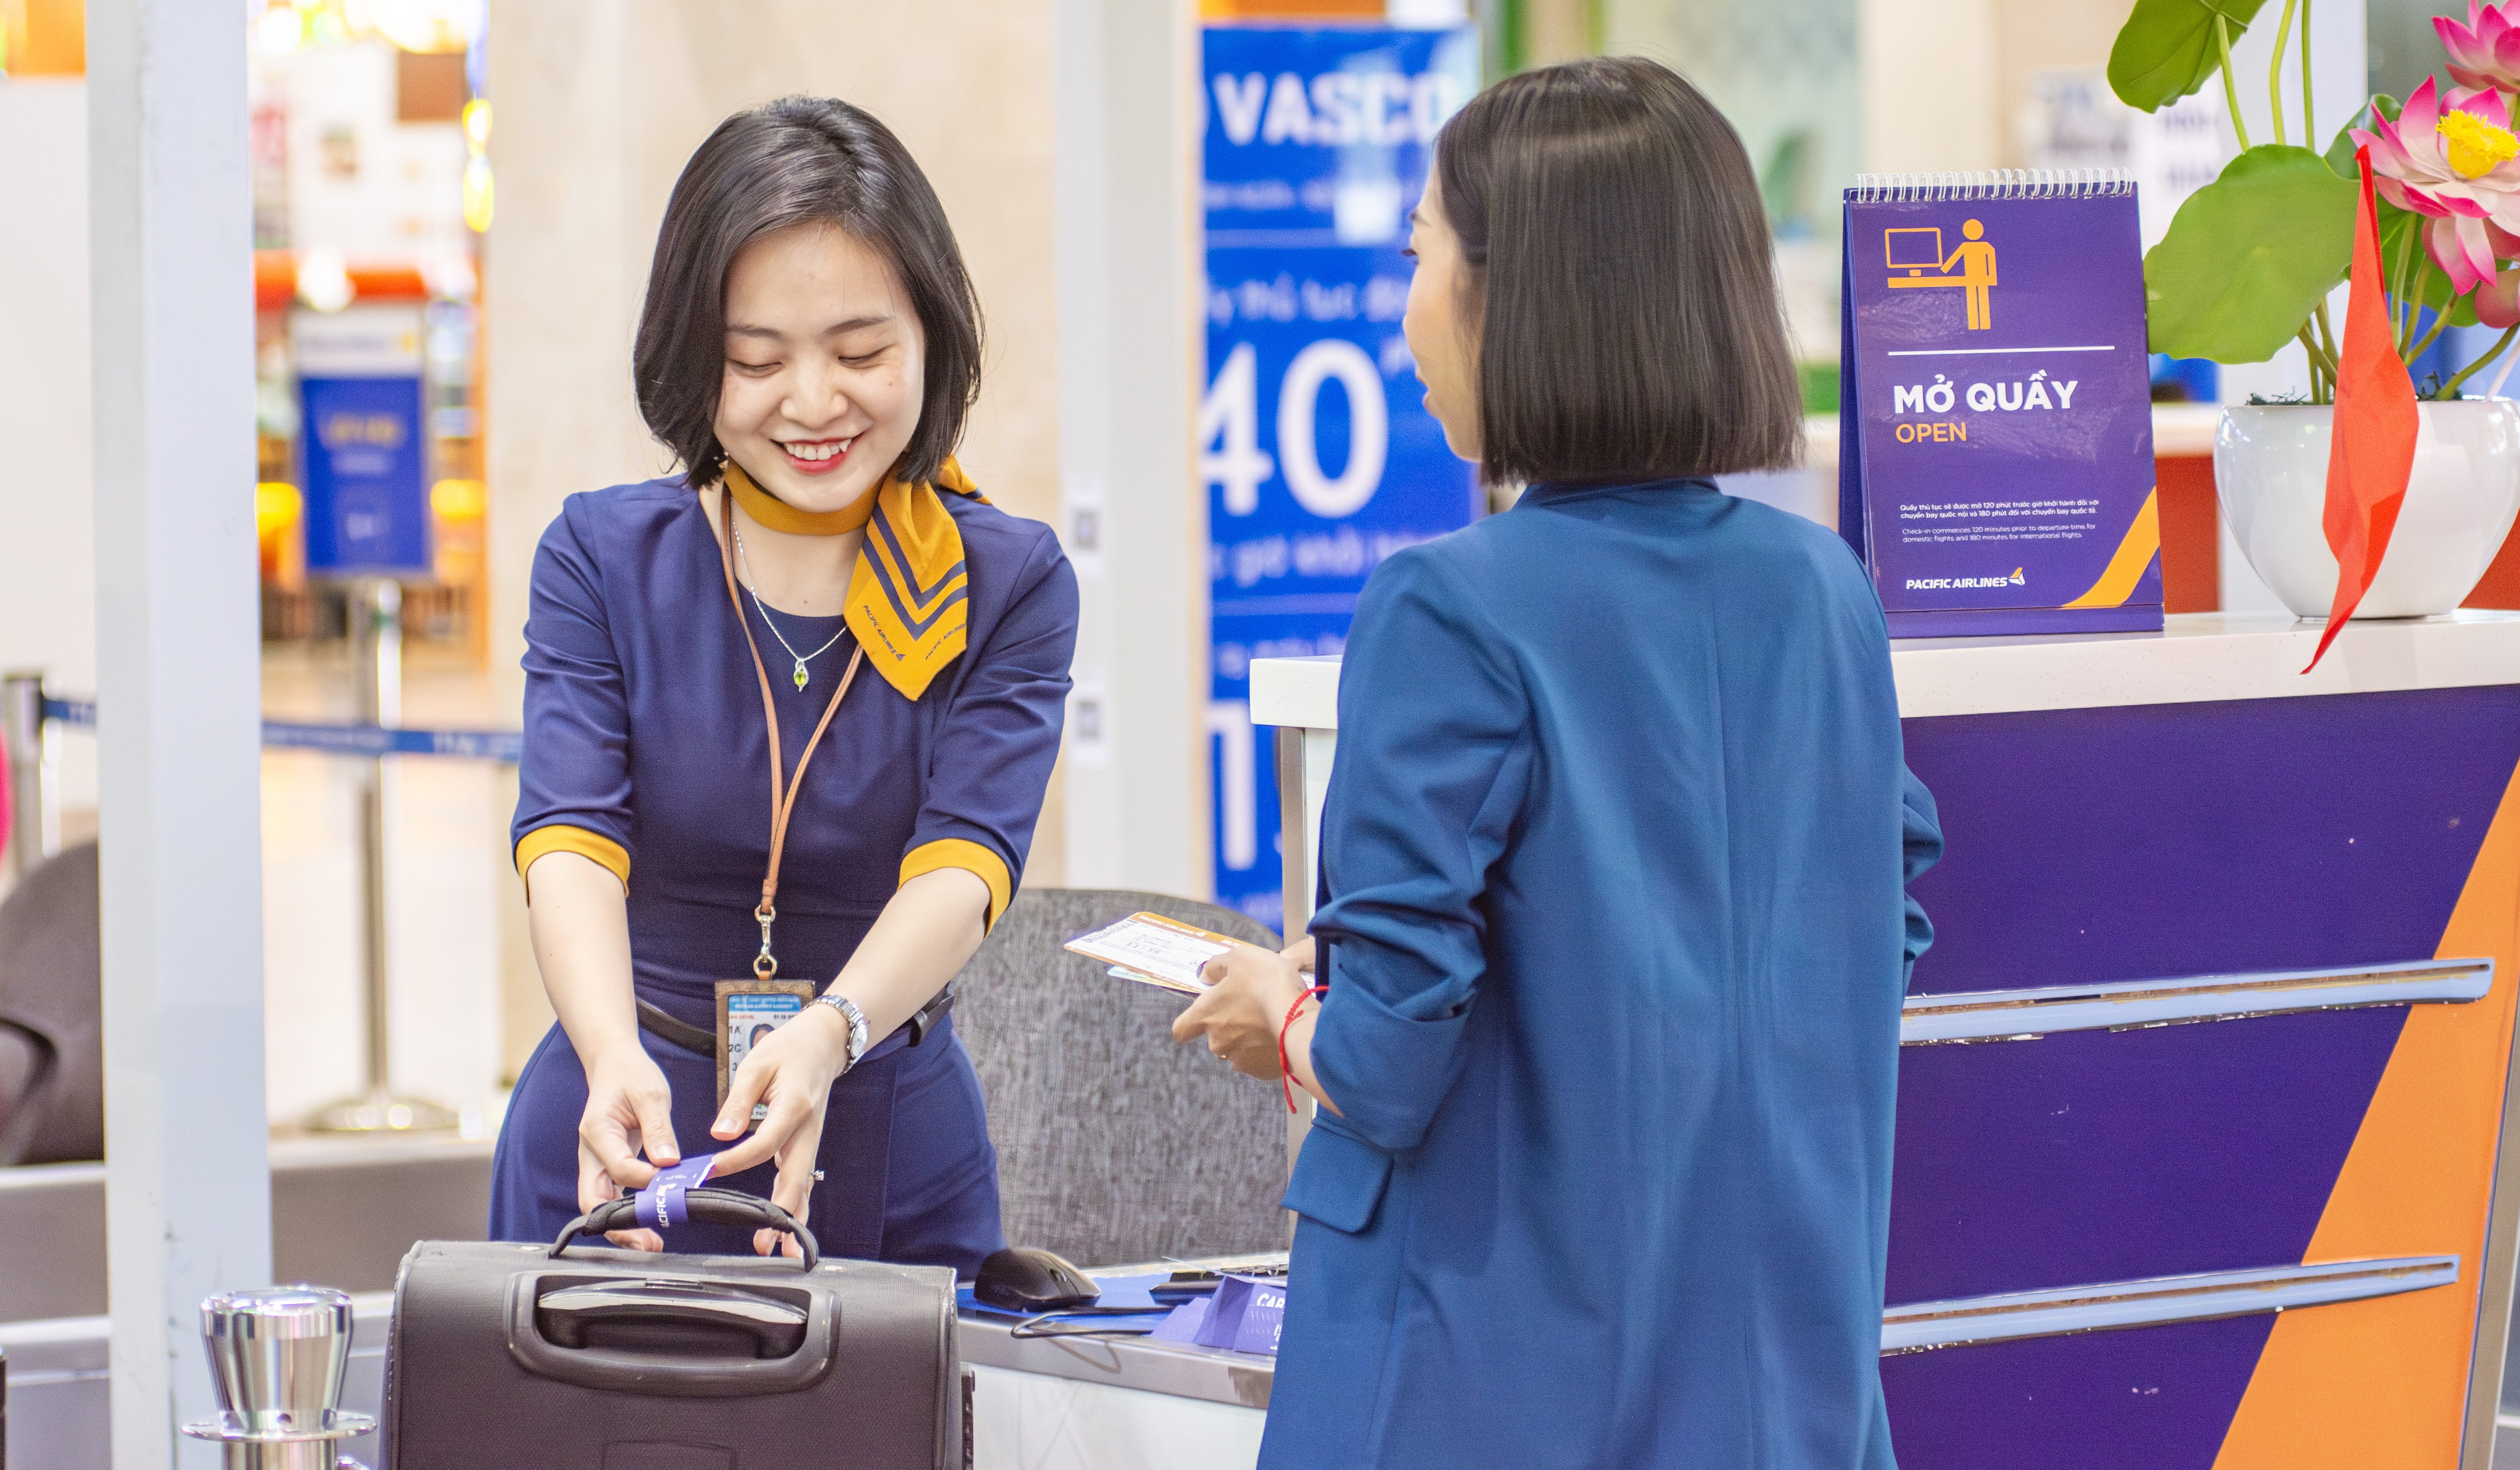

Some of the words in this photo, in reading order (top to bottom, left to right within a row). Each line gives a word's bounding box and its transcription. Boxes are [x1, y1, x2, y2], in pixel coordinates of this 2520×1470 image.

[1212, 72, 1459, 145] VASCO
[1893, 374, 1955, 413] MỞ
[1966, 369, 2078, 412] QUẦY
[1895, 422, 1967, 443] OPEN
[1906, 579, 1952, 590] PACIFIC
[1952, 577, 2008, 588] AIRLINES
[863, 605, 880, 628] PACIFIC
[877, 629, 897, 655] AIRLINES
